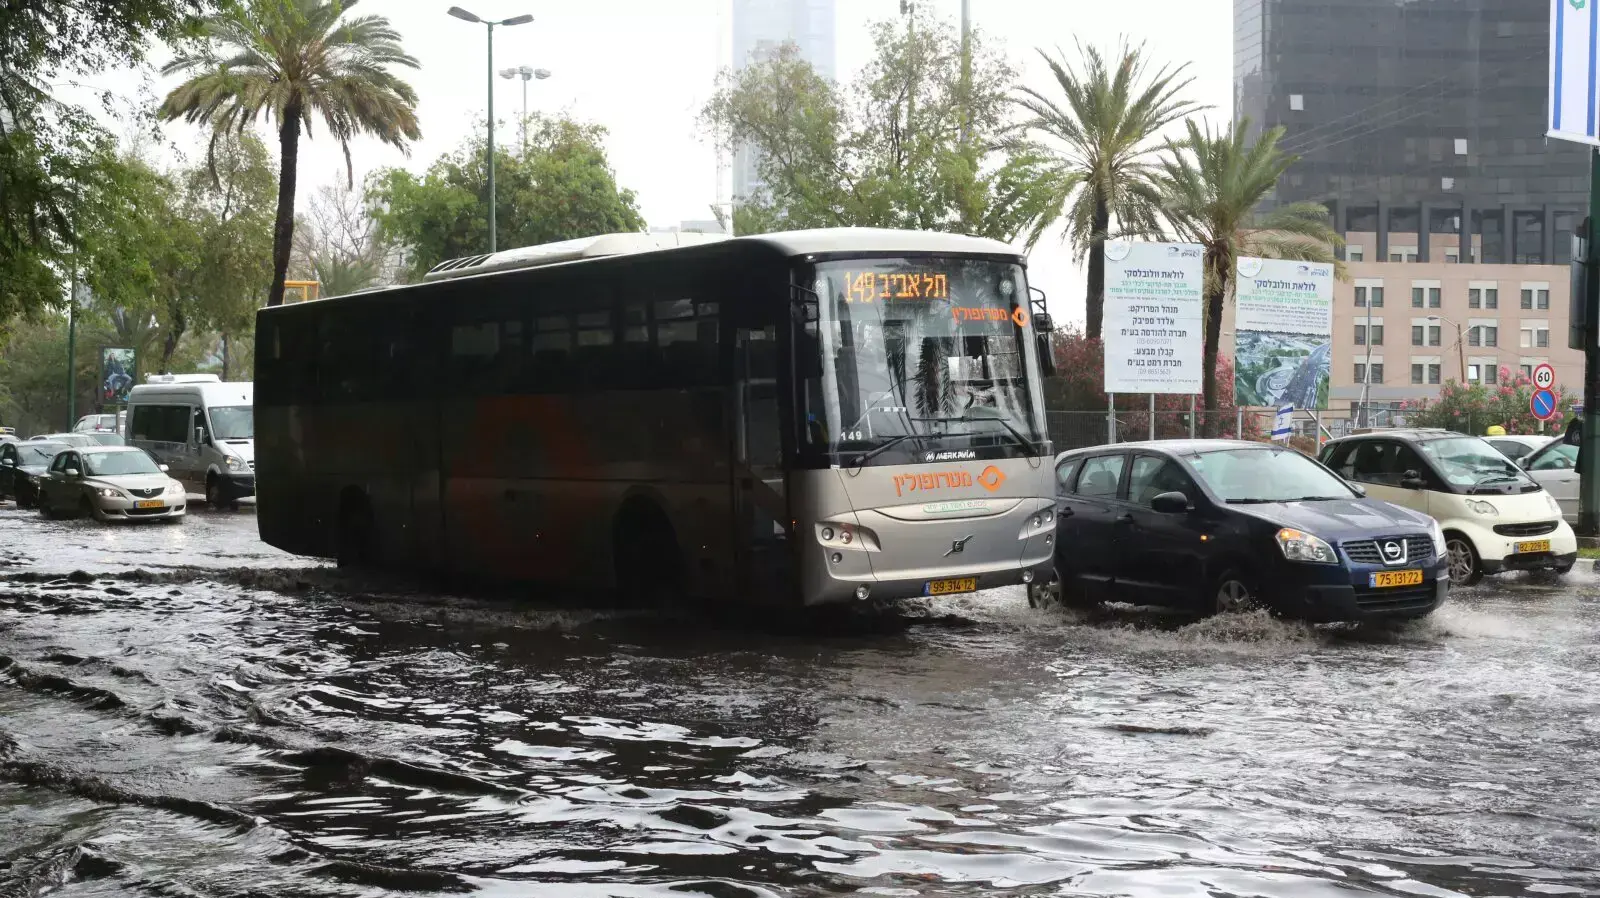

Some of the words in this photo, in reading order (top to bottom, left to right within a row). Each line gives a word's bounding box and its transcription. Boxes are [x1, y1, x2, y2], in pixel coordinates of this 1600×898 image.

[1124, 268, 1160, 278] וולובלסקי
[1161, 270, 1184, 279] לולאת
[843, 271, 875, 303] 149
[879, 273, 920, 298] אביב
[922, 272, 947, 298] תל
[1254, 279, 1291, 290] וולובלסקי
[1292, 282, 1316, 291] לולאת
[1128, 305, 1160, 314] הפרויקט:
[1161, 305, 1178, 313] מנהל
[952, 307, 1008, 326] מטרופולין
[1156, 316, 1175, 325] אלדר
[1132, 317, 1155, 326] ספיבק
[1140, 328, 1167, 336] להנדסה
[1168, 329, 1187, 338] חברה
[1134, 347, 1156, 355] מבצע:
[1157, 347, 1174, 357] קבלן
[1163, 359, 1182, 367] חברת
[1537, 371, 1550, 383] 60
[840, 430, 862, 441] 149
[892, 471, 972, 497] מטרופולין
